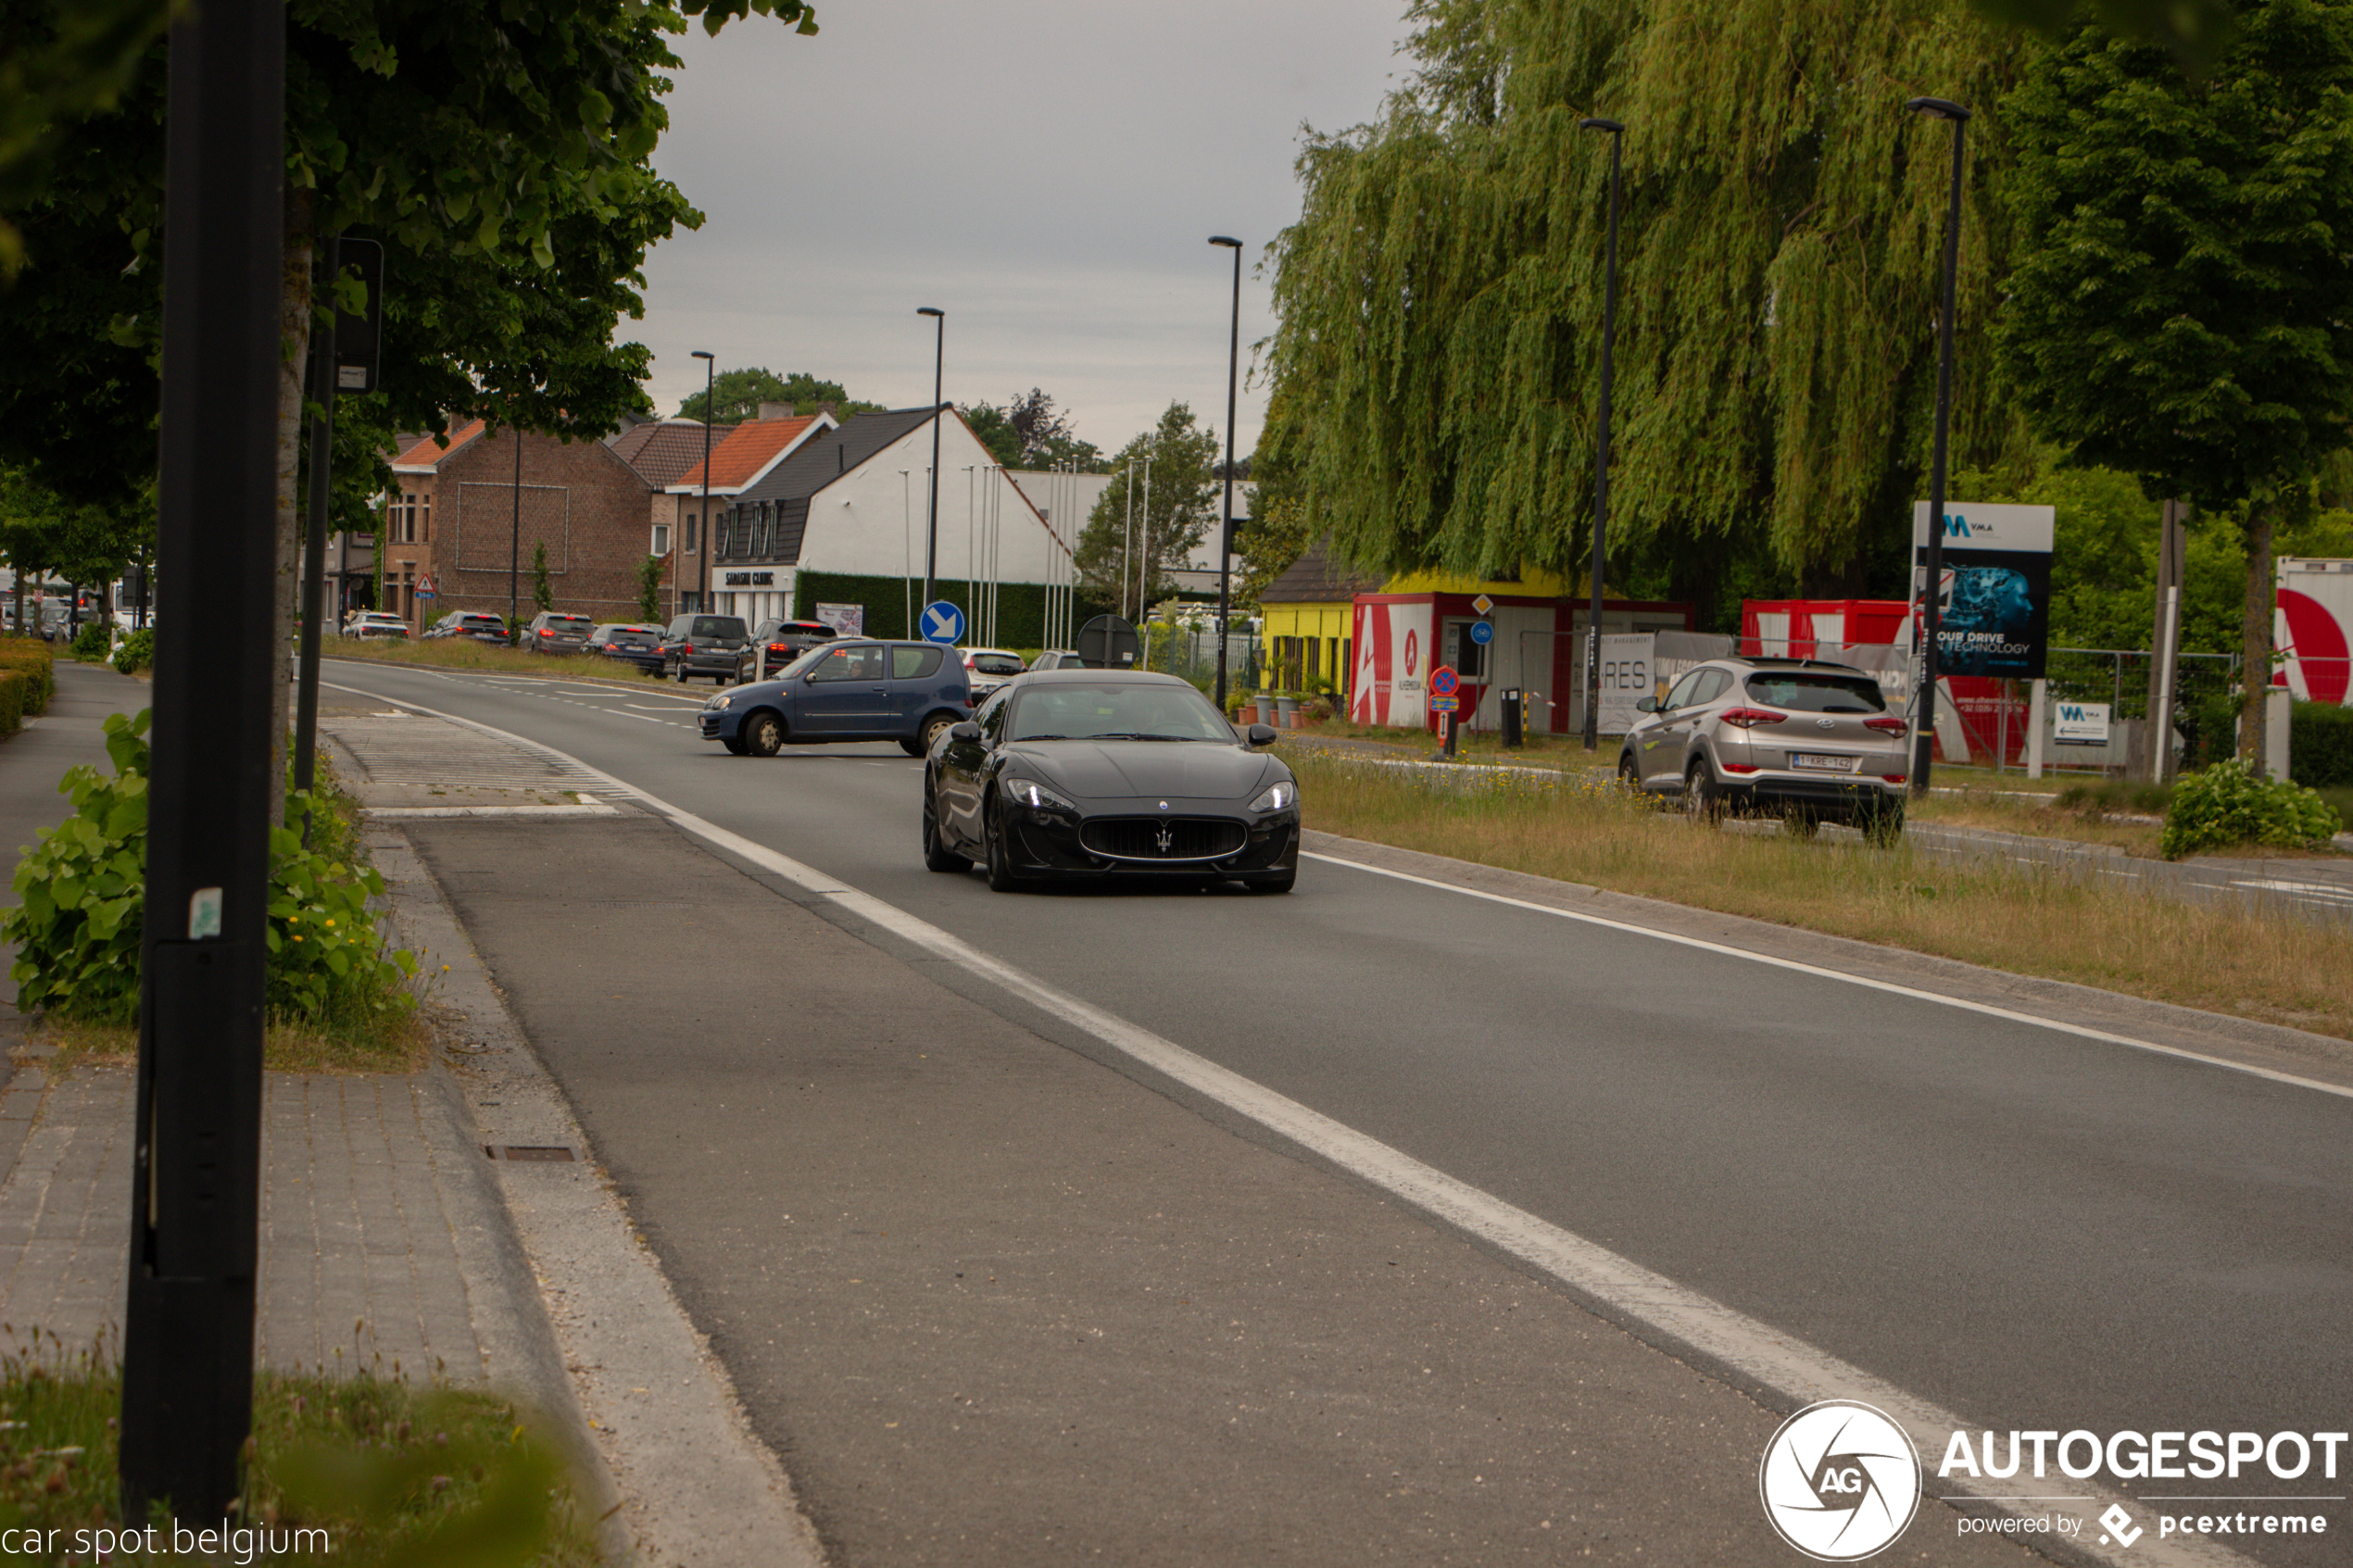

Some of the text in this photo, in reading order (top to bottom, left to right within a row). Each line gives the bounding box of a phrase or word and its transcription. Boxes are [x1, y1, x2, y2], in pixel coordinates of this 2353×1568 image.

[1970, 522, 1994, 532] VMA
[1967, 632, 2005, 644] DRIVE
[1946, 641, 2031, 654] TECHNOLOGY
